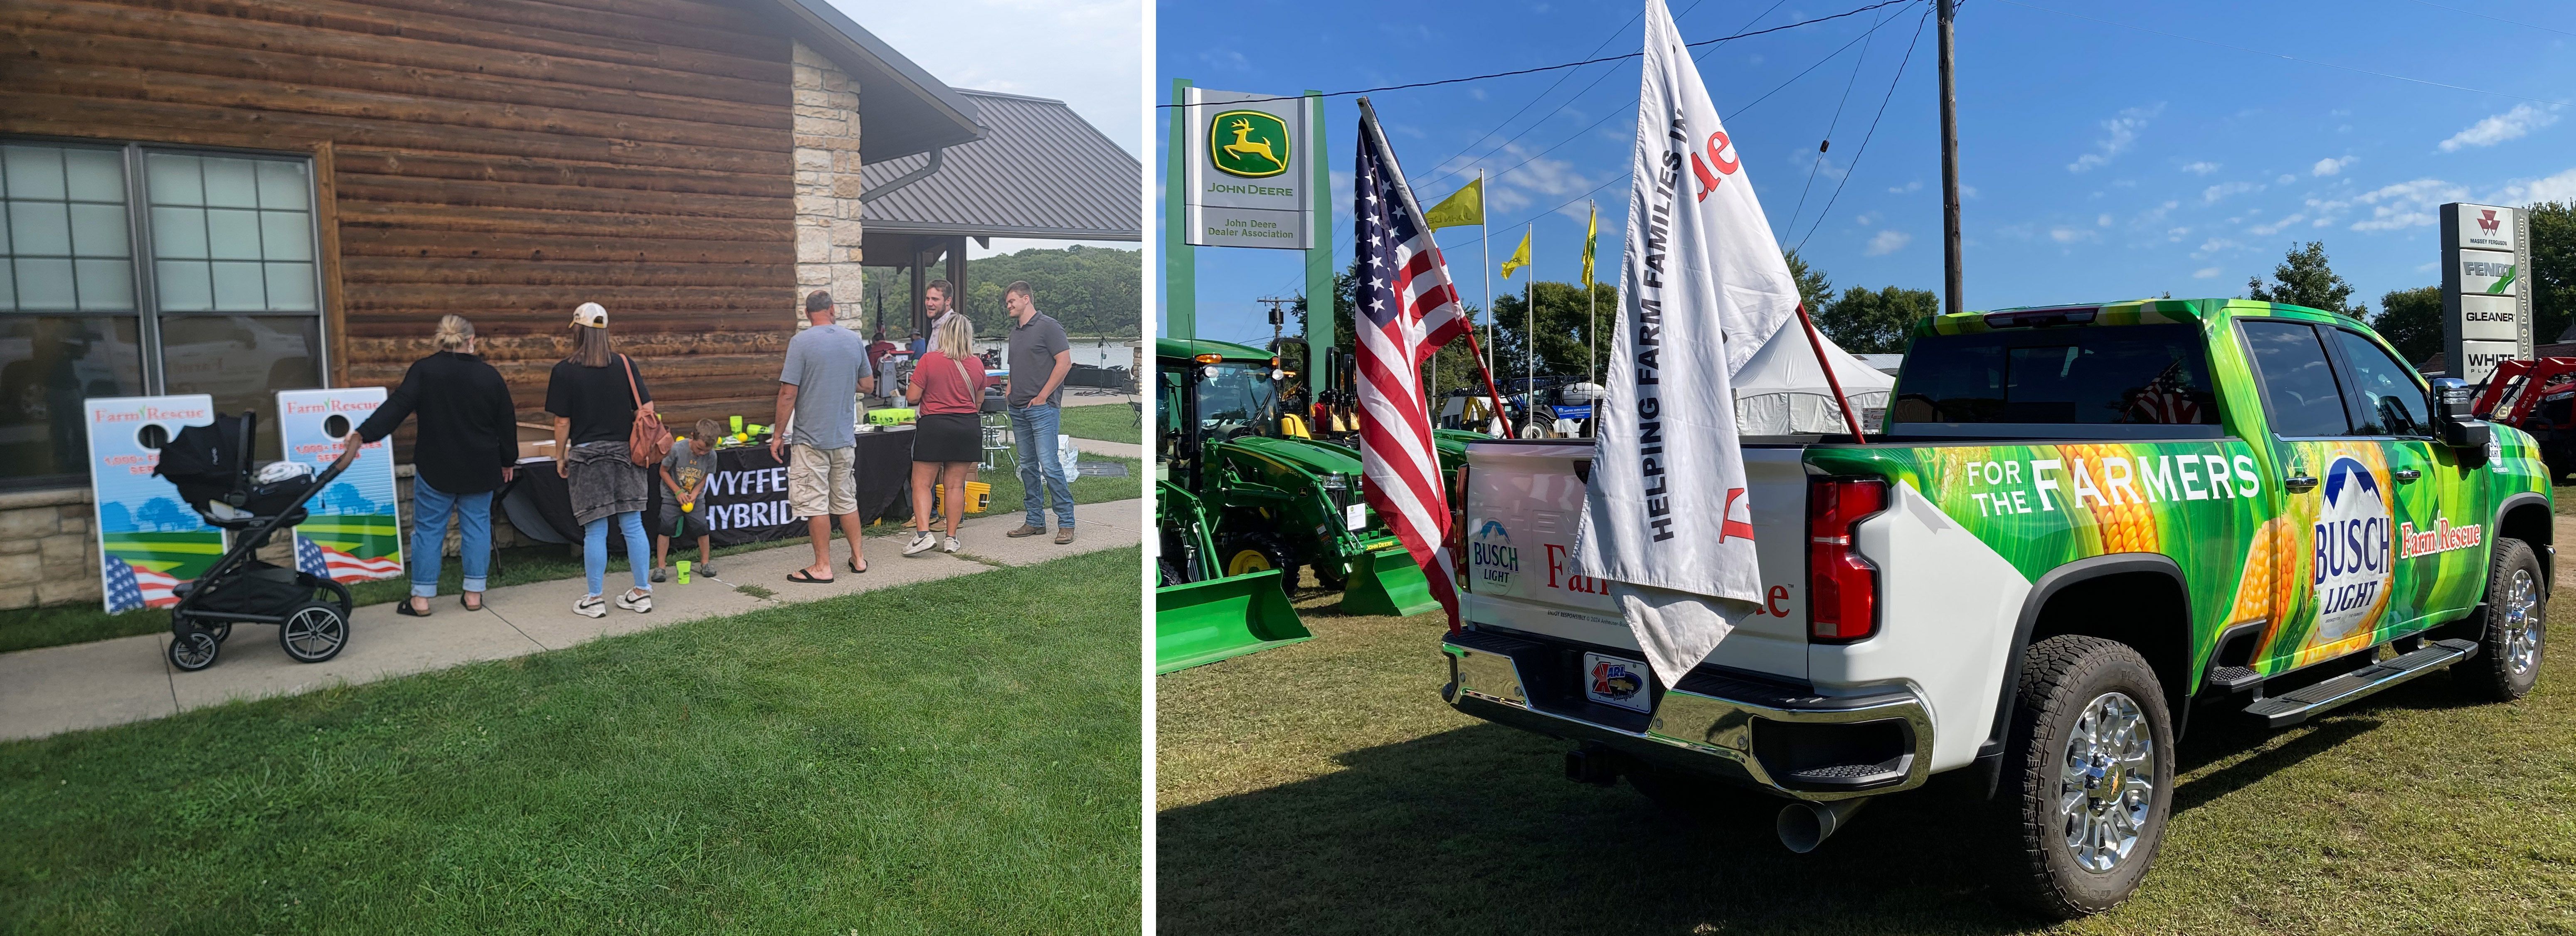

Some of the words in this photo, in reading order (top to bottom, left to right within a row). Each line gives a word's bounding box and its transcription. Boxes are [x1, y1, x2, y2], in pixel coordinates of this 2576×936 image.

[1208, 182, 1245, 194] JOHN
[1248, 185, 1293, 197] DEERE
[1208, 227, 1238, 236] Dealer
[1241, 229, 1293, 239] Association
[1225, 219, 1247, 227] John
[1250, 219, 1277, 229] Deere
[1643, 150, 1682, 288] FAMILIES
[2519, 217, 2527, 285] Association
[2463, 261, 2512, 277] FENDT
[2466, 312, 2514, 322] GLEANER
[1638, 298, 1661, 385] FARM
[95, 409, 140, 422] Farm
[147, 407, 204, 420] Rescue
[287, 402, 325, 414] Farm
[331, 400, 379, 411] Rescue
[705, 466, 791, 496] WYFFE
[1638, 397, 1674, 542] HELPING
[1967, 460, 2022, 486] FOR
[2030, 453, 2260, 512] FARMERS
[706, 500, 808, 531] HYBRID
[1972, 490, 2032, 517] THE
[2315, 517, 2389, 585] BUSCH
[2402, 524, 2436, 557] Farm
[2440, 519, 2480, 549] Rescue
[1474, 542, 1518, 571] BUSCH
[1484, 569, 1509, 583] LIGHT
[2322, 581, 2378, 615] LIGHT
[1560, 612, 1586, 621] RESPONSIBLY
